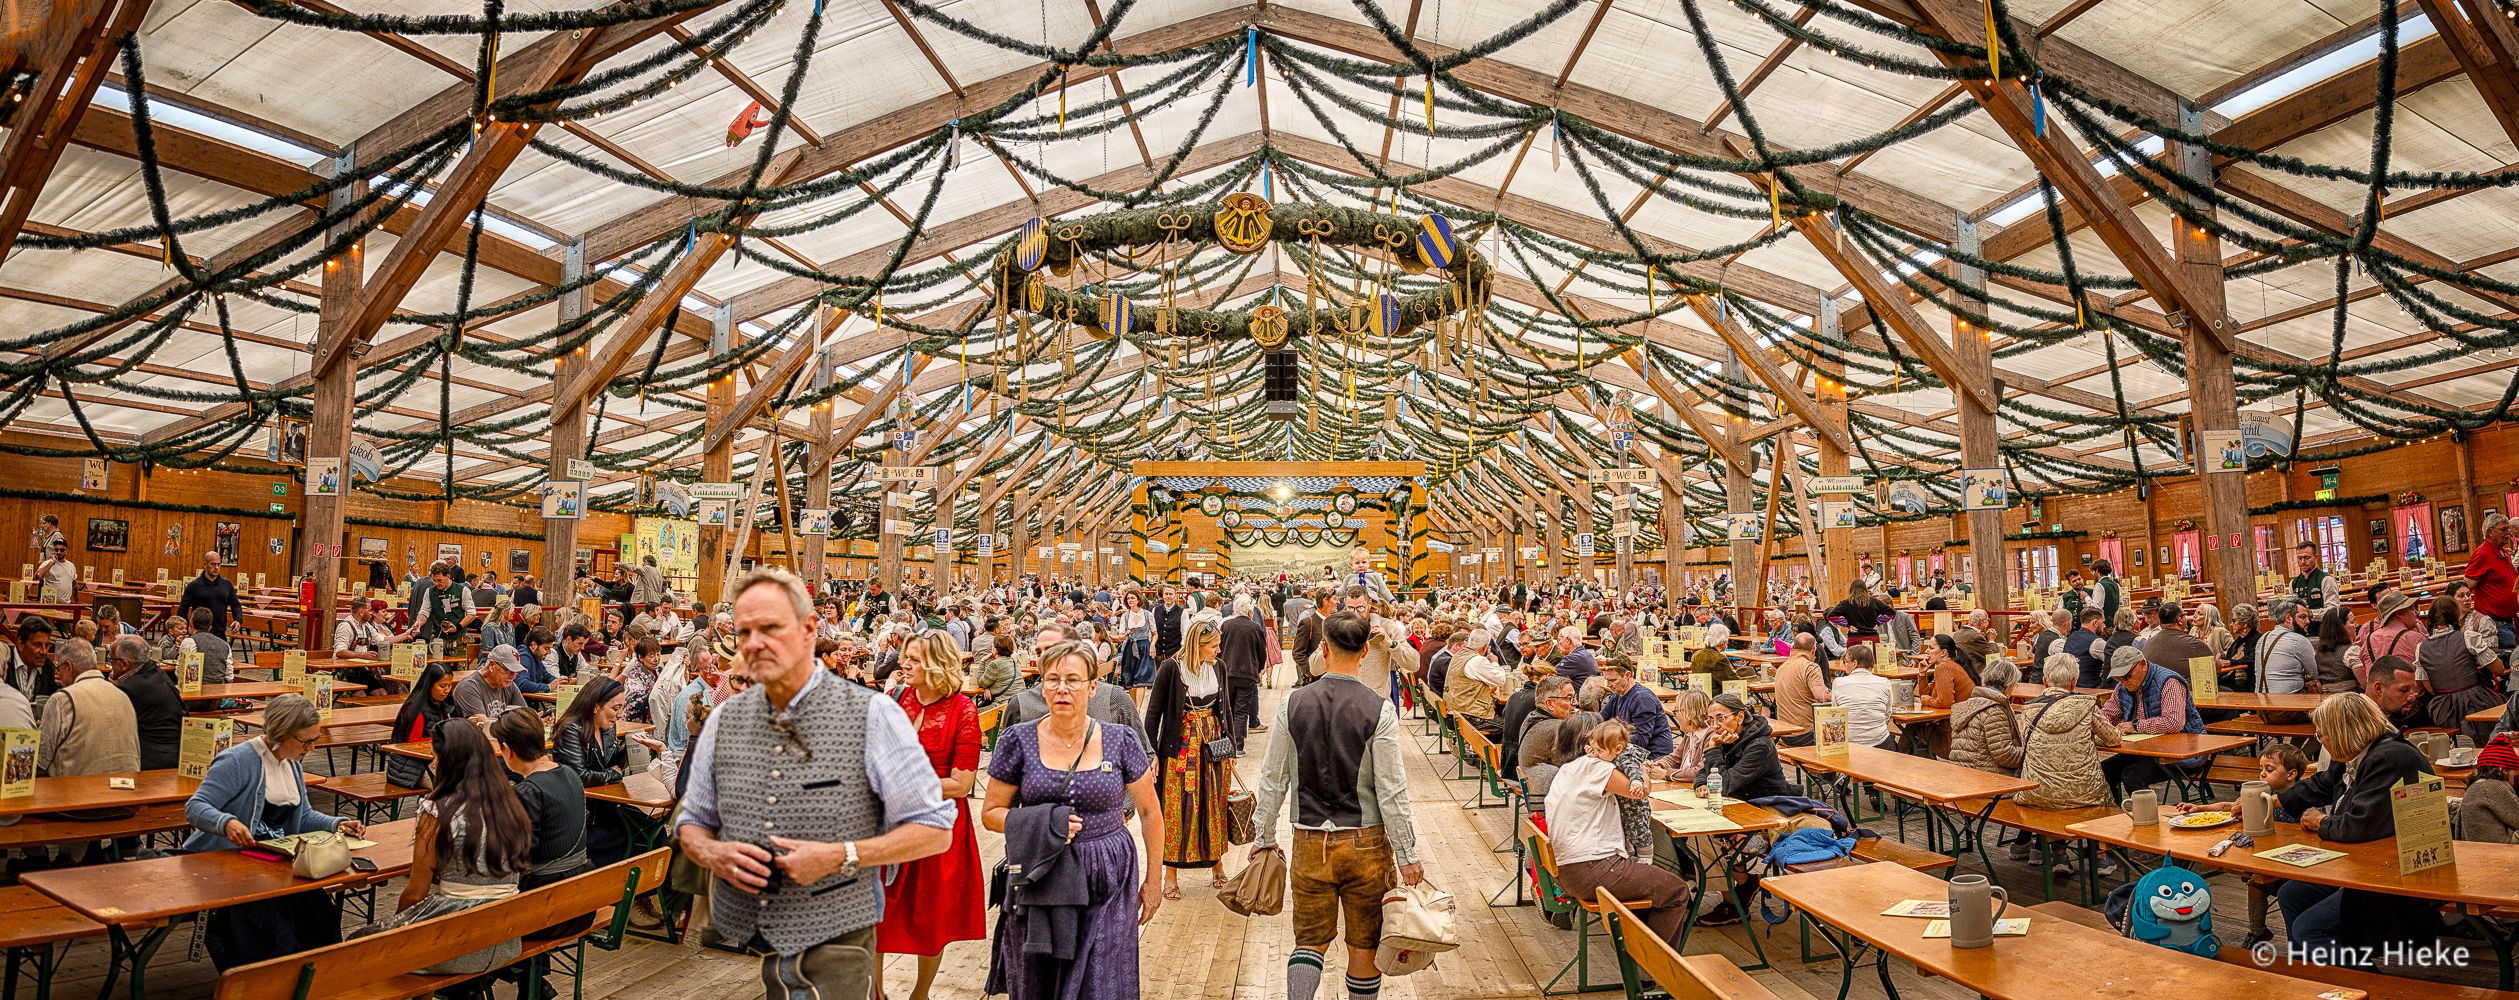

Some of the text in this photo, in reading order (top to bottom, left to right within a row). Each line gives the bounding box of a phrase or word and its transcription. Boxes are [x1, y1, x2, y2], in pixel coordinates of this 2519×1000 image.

[2245, 412, 2272, 424] August
[891, 468, 909, 478] WC
[1612, 470, 1631, 480] WC
[2325, 476, 2337, 486] W-4
